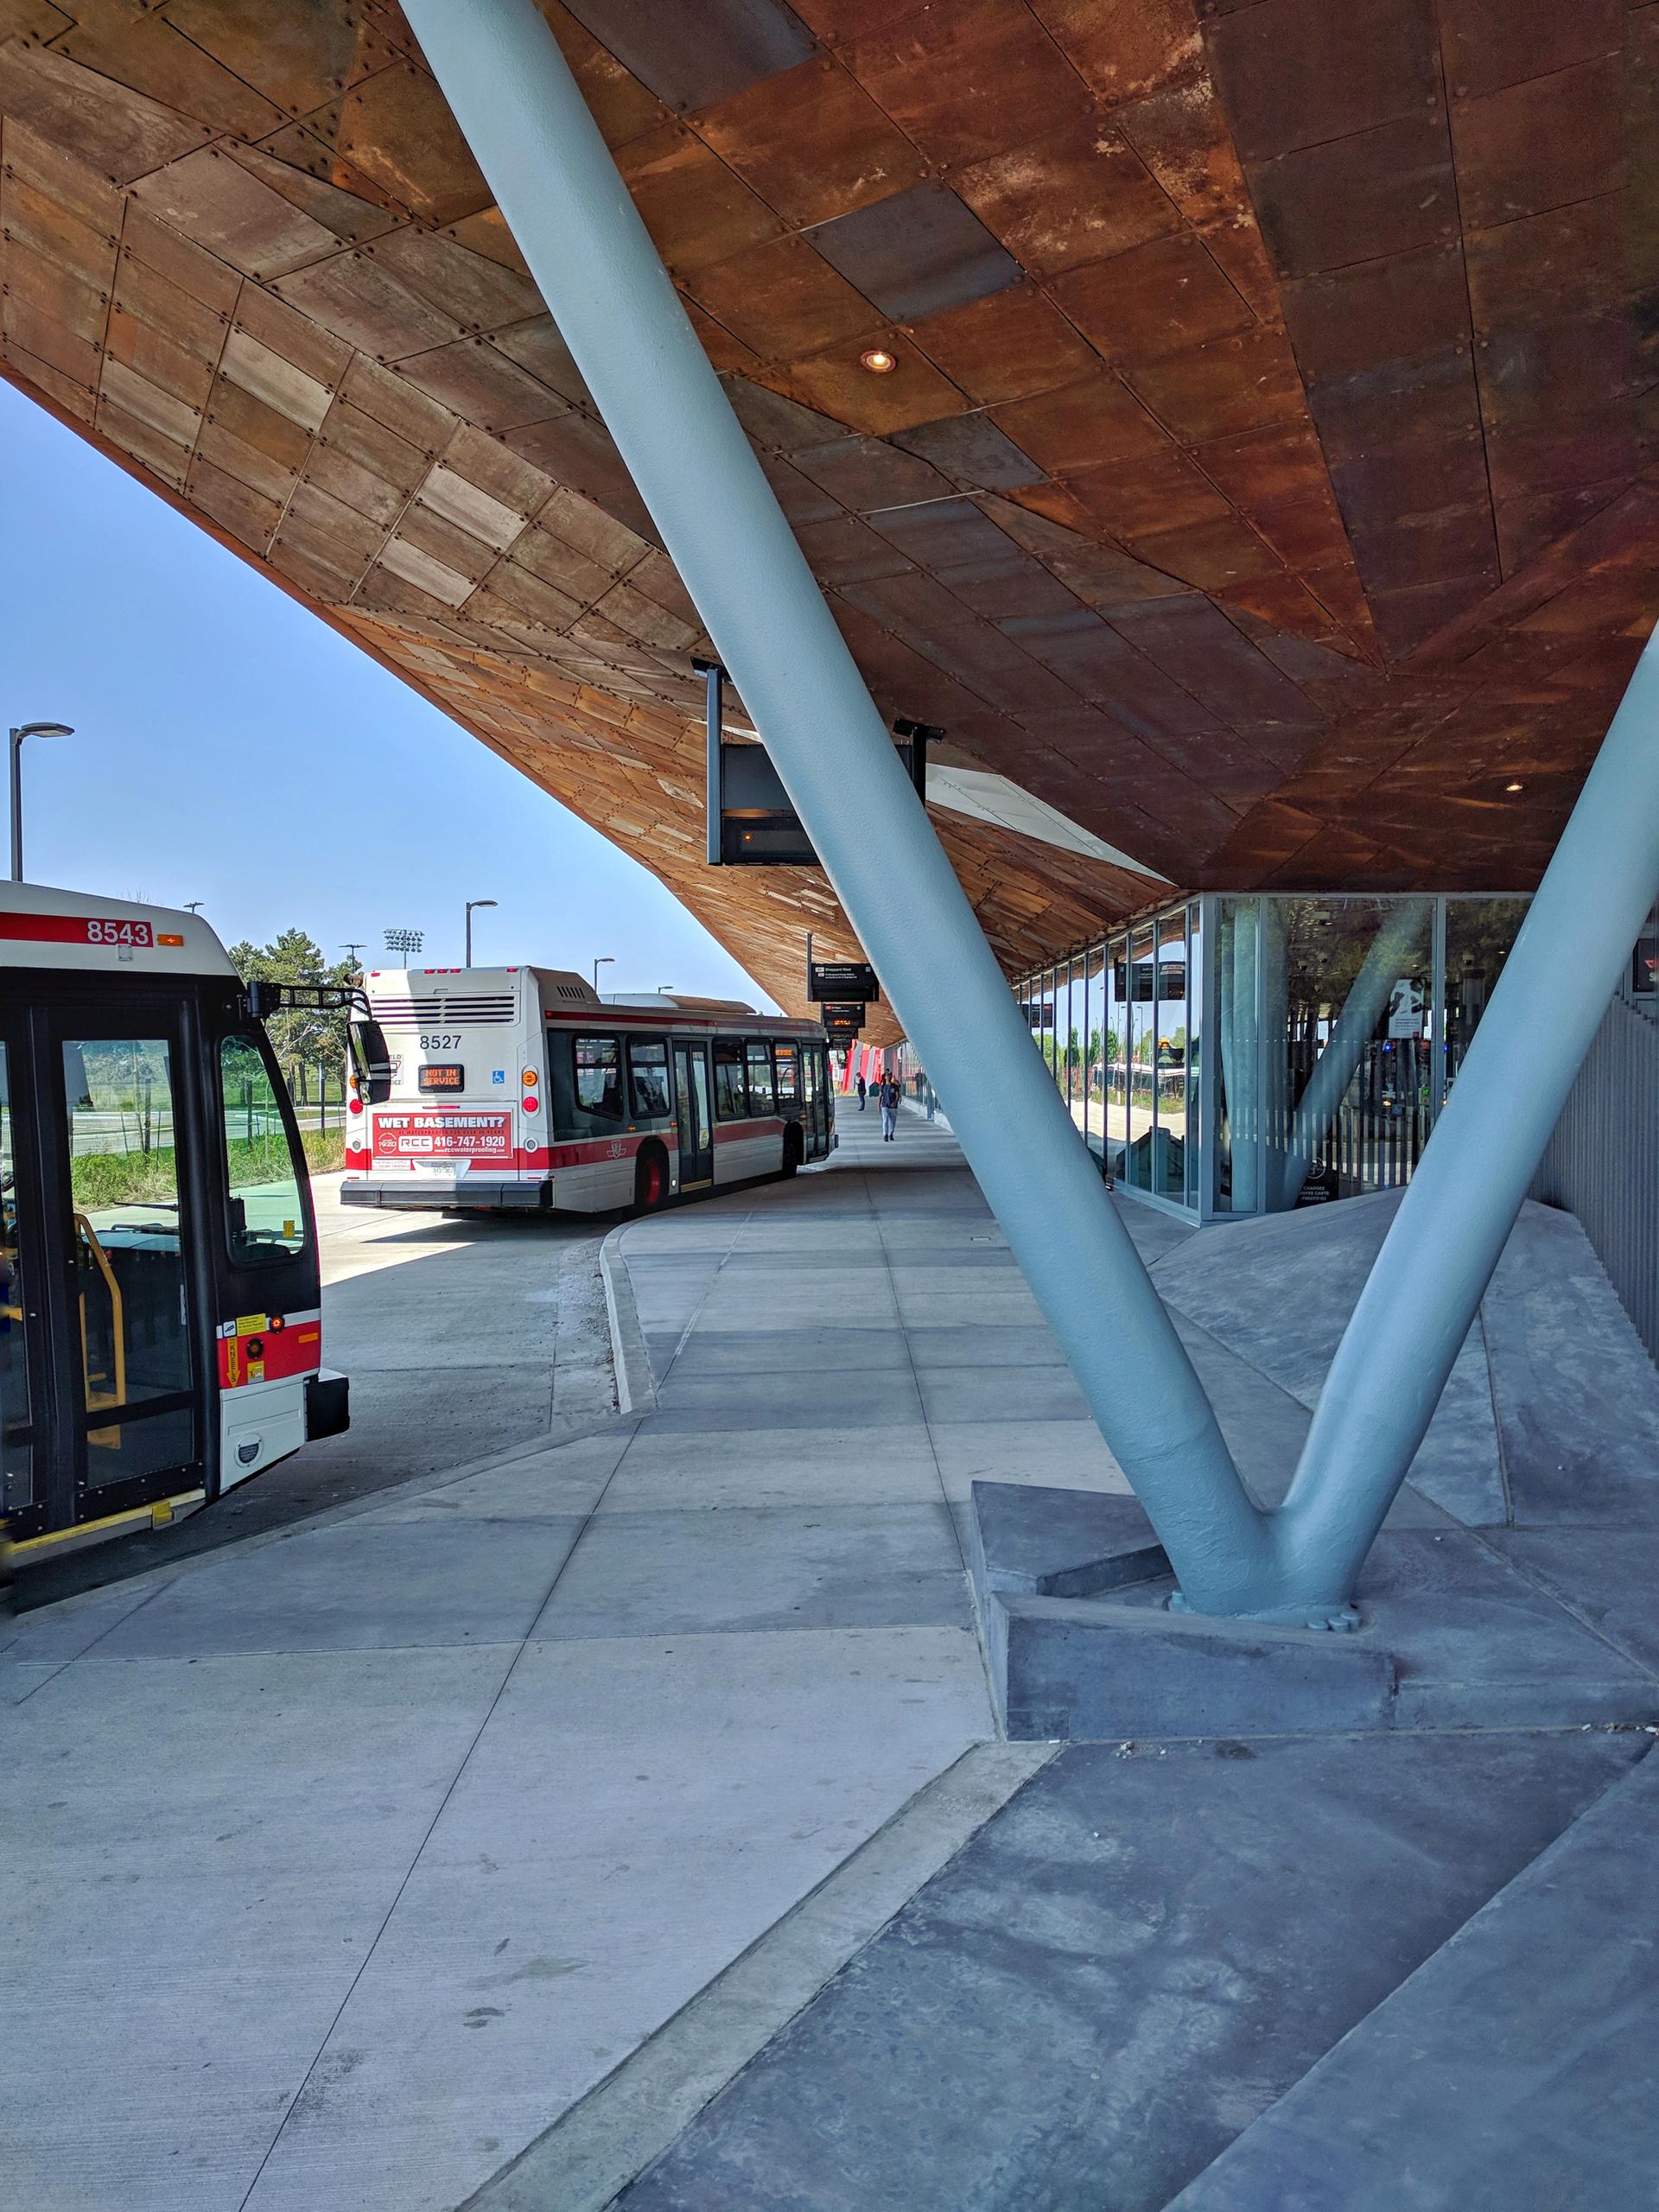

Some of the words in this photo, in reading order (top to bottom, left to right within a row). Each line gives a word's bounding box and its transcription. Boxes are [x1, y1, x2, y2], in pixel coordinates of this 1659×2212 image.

[87, 920, 149, 945] 8543
[420, 1035, 461, 1049] 8527
[423, 1077, 460, 1085] SERVICE
[378, 1117, 410, 1128] WET
[414, 1116, 505, 1128] BASEMENT?
[401, 1138, 429, 1147] RCC
[434, 1136, 505, 1147] 416-747-1920
